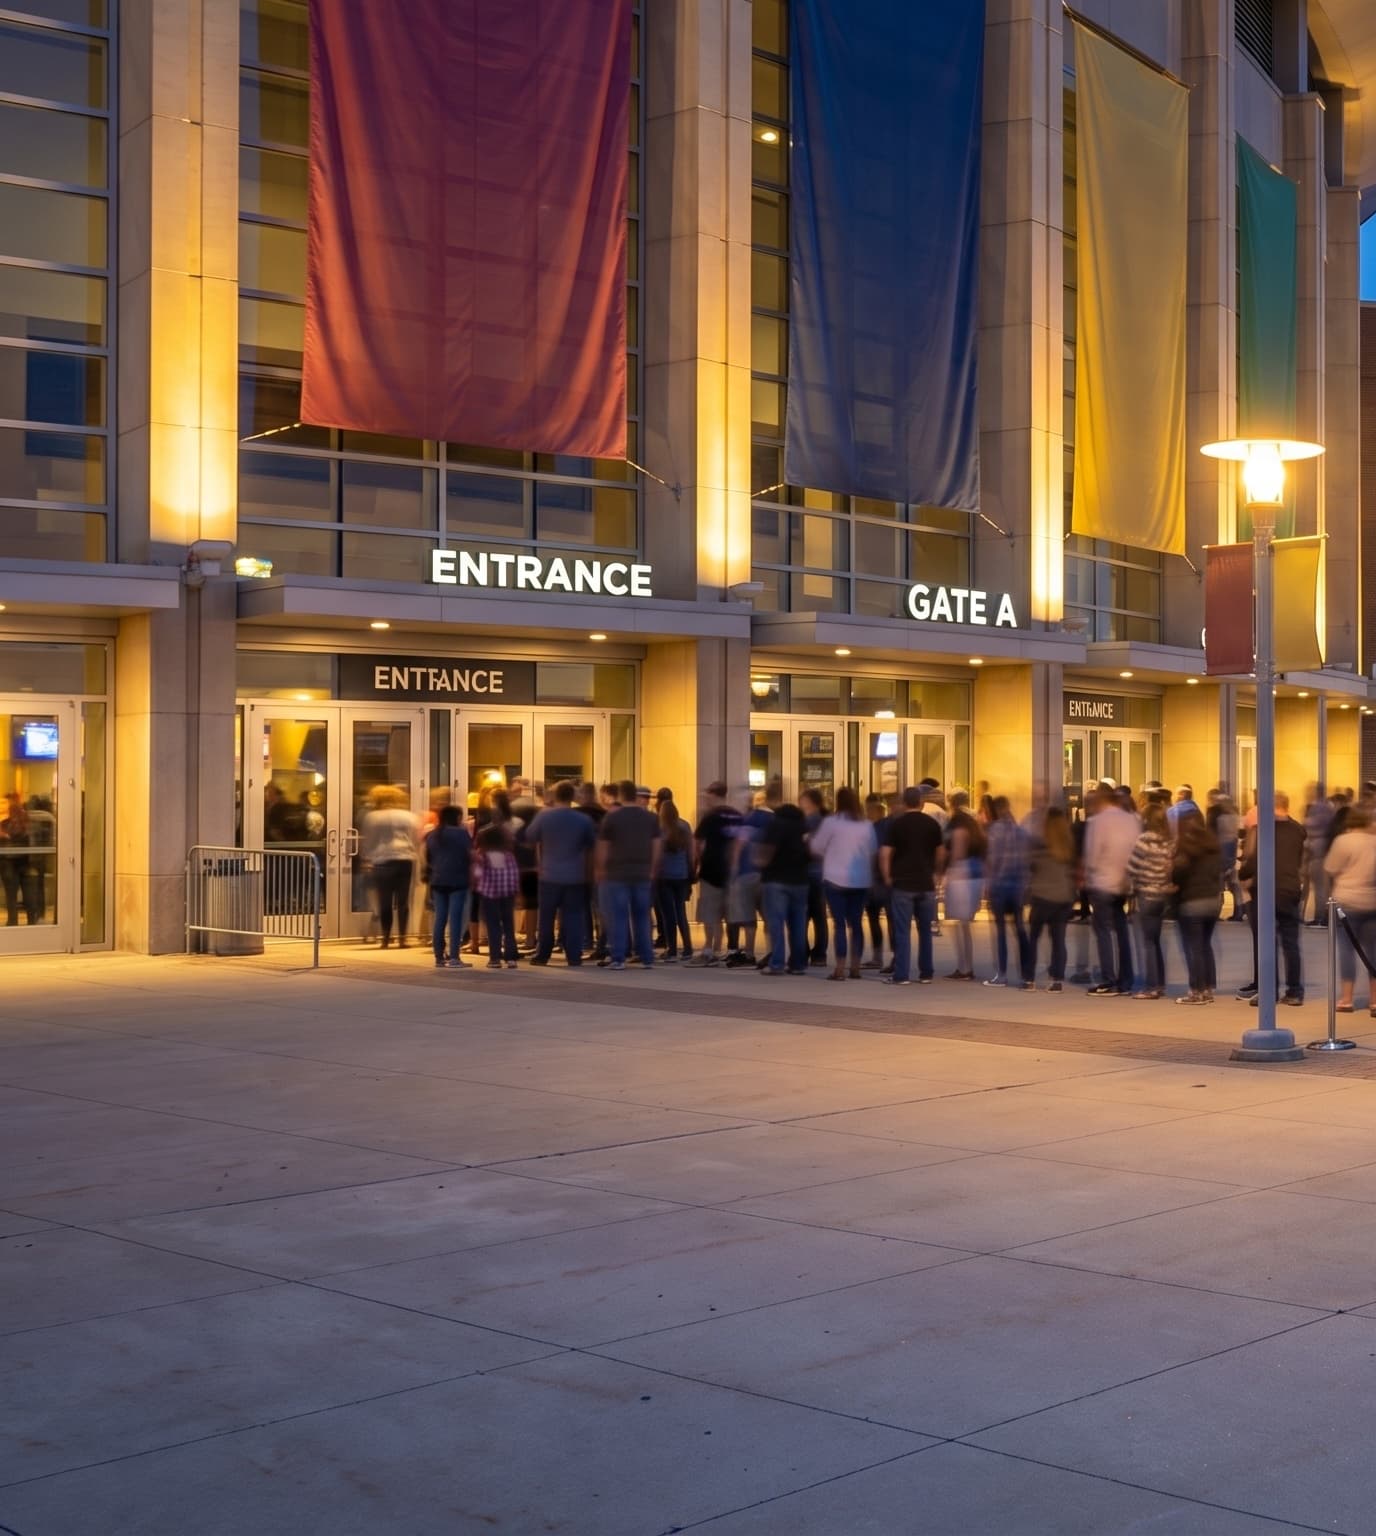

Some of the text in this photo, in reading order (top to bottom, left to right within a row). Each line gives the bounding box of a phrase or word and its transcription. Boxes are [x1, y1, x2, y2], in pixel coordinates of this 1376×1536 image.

[432, 549, 652, 597] ENTRANCE
[908, 584, 1018, 628] GATE A
